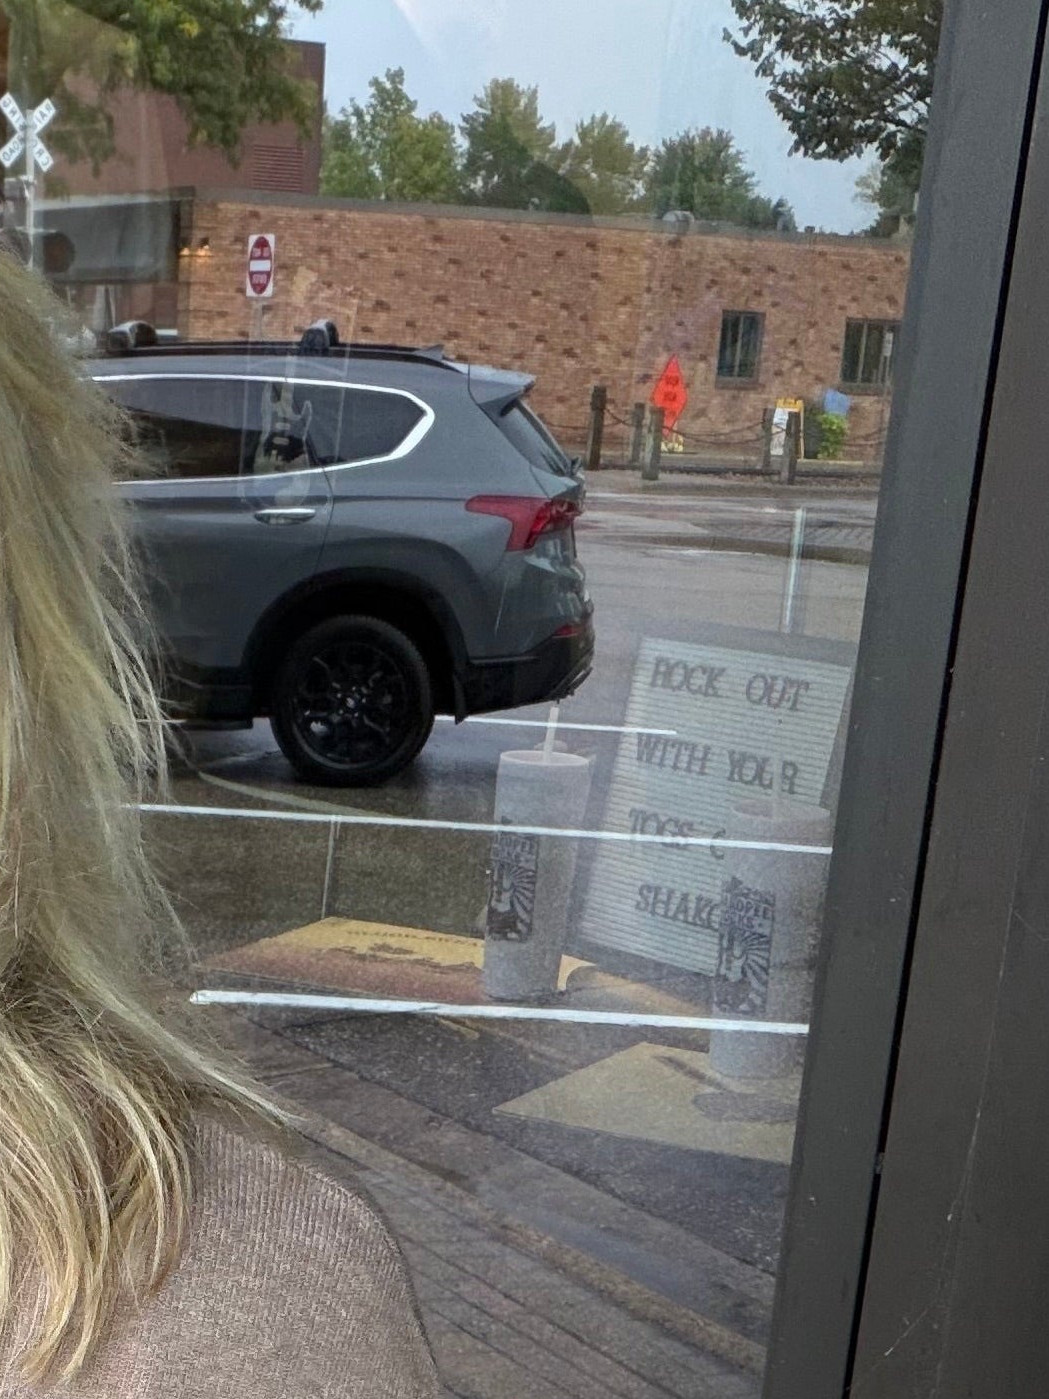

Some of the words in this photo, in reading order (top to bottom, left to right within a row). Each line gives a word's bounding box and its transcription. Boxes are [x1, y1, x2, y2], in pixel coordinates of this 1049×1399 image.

[651, 656, 726, 698] ROCK
[746, 673, 810, 711] OUT
[637, 733, 711, 776] WITH
